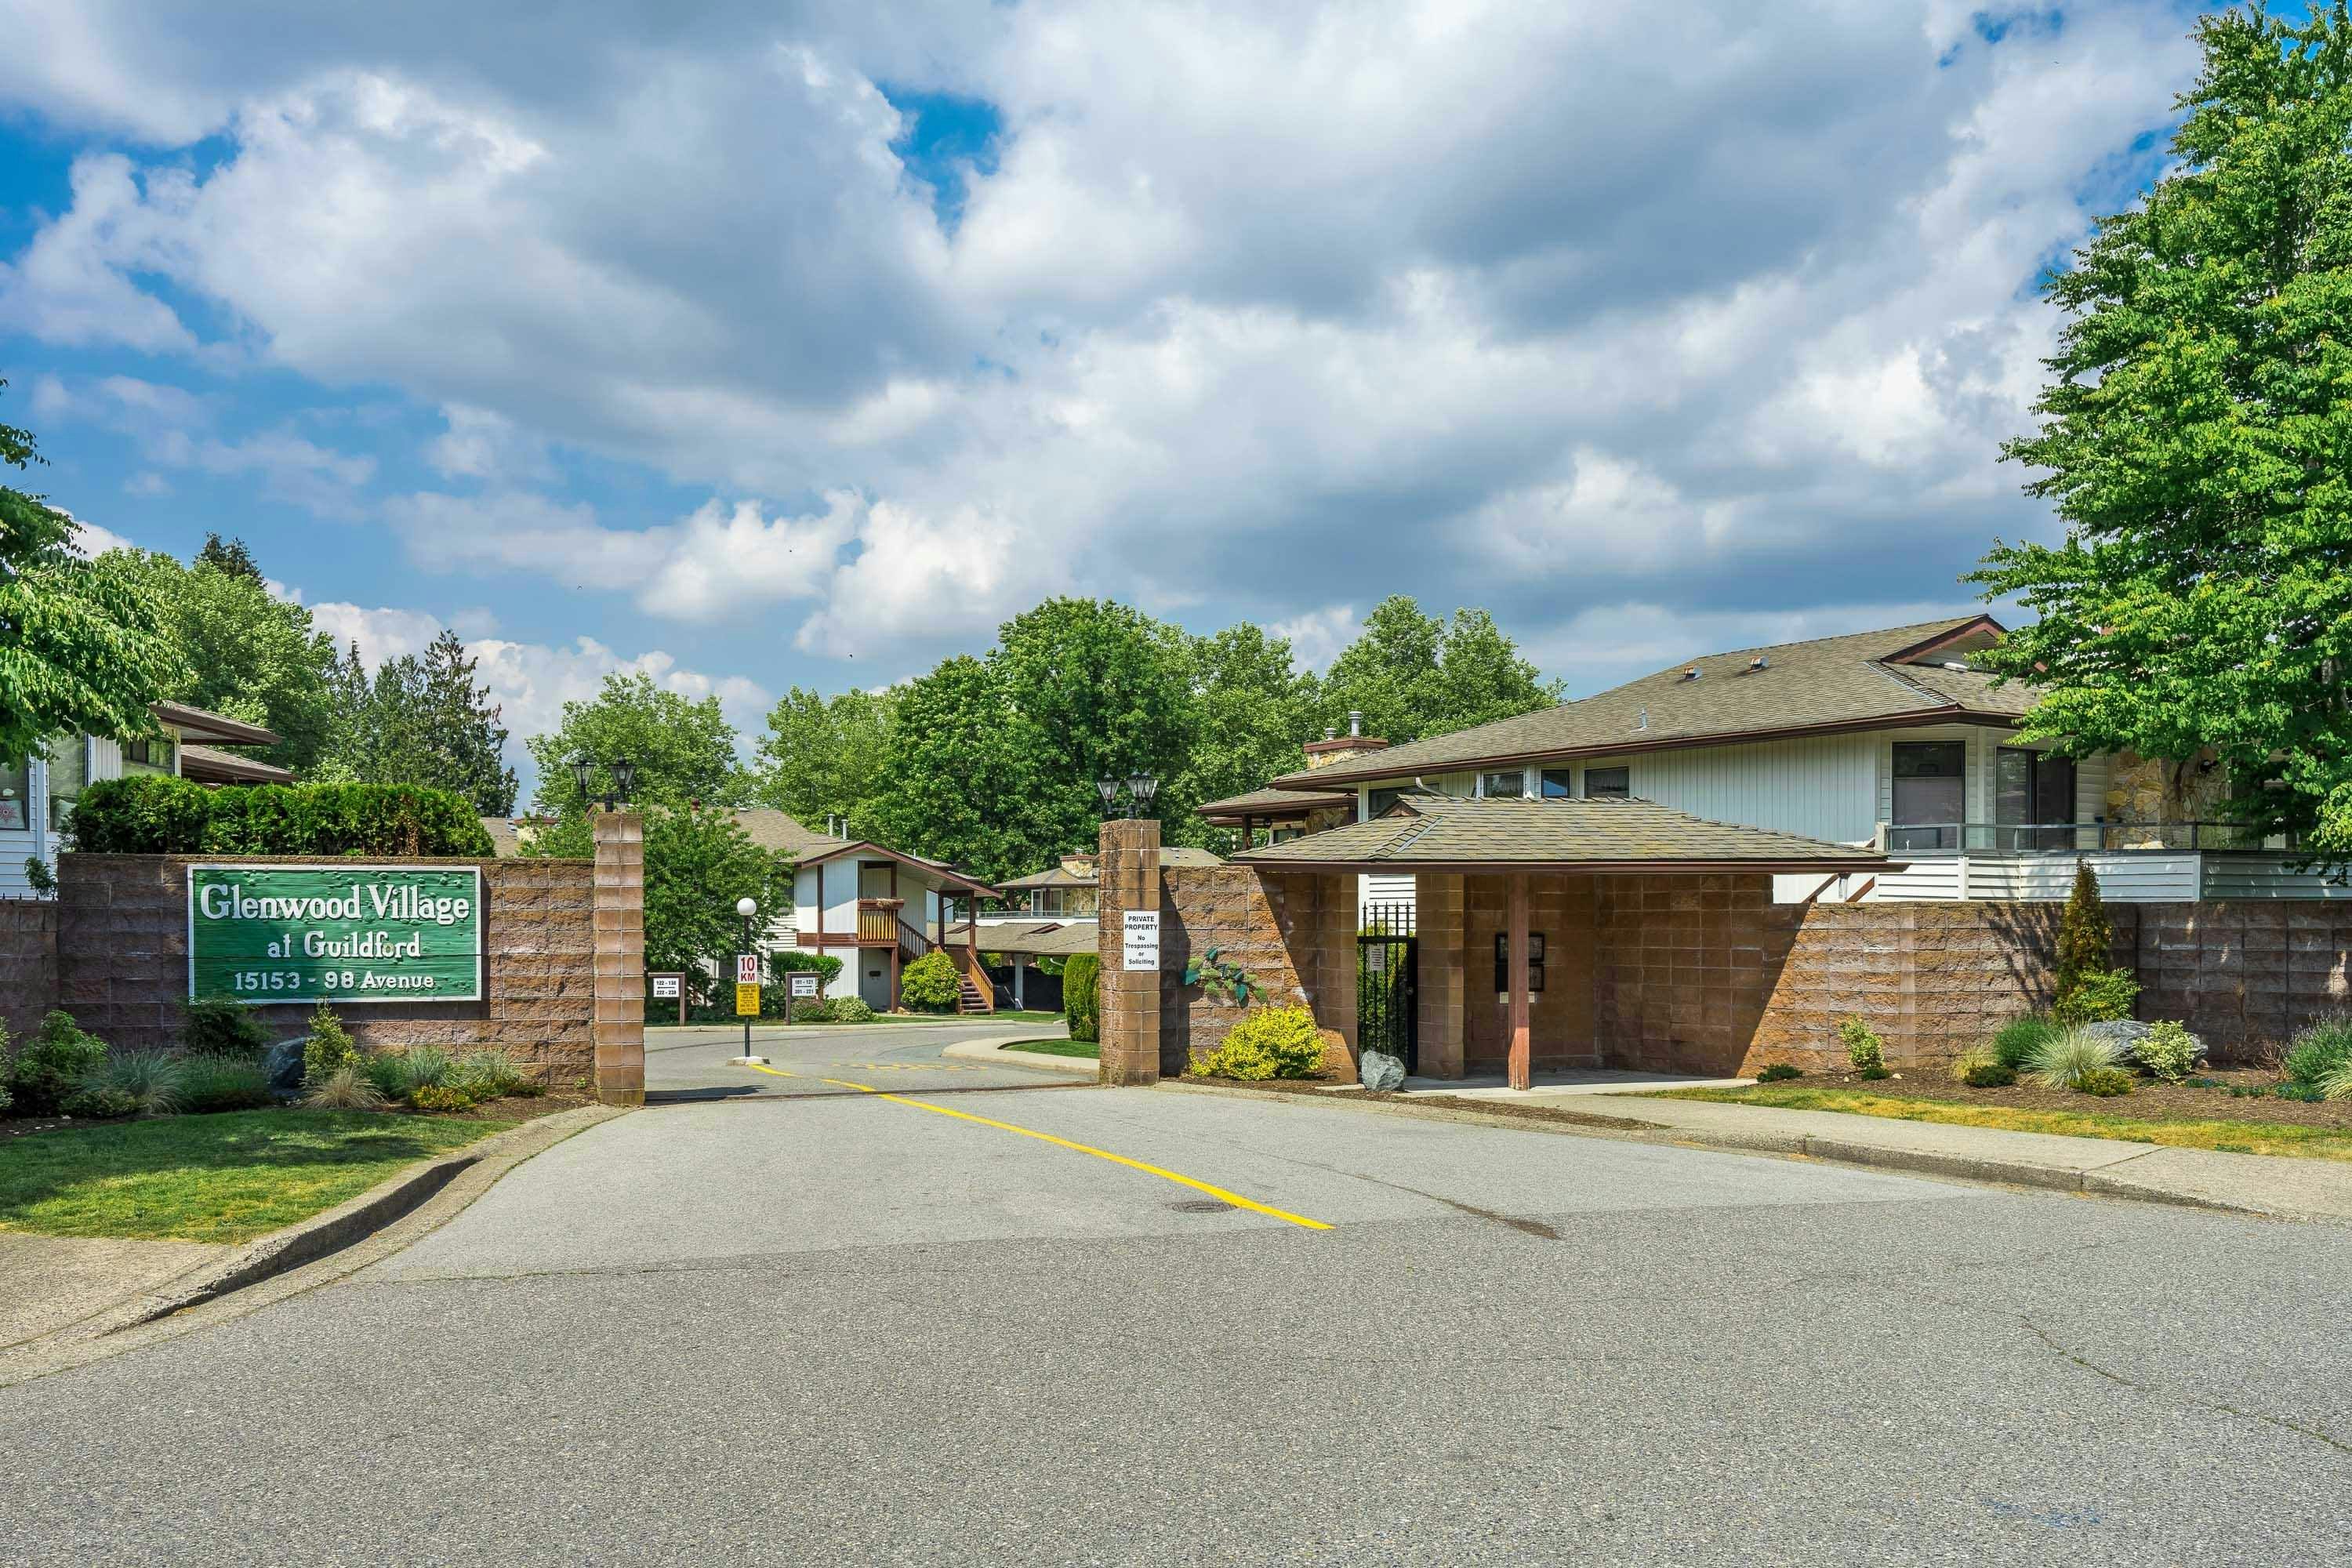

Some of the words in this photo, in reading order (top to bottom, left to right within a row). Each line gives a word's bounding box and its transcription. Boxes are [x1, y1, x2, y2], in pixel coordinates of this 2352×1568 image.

[200, 884, 362, 920] Glenwood
[366, 884, 470, 925] Village
[267, 933, 291, 958] at
[304, 931, 422, 958] Guildford
[741, 956, 755, 971] 10
[234, 971, 301, 991] 15153
[324, 971, 354, 989] 98
[359, 971, 435, 989] Avenue
[741, 973, 755, 982] KM
